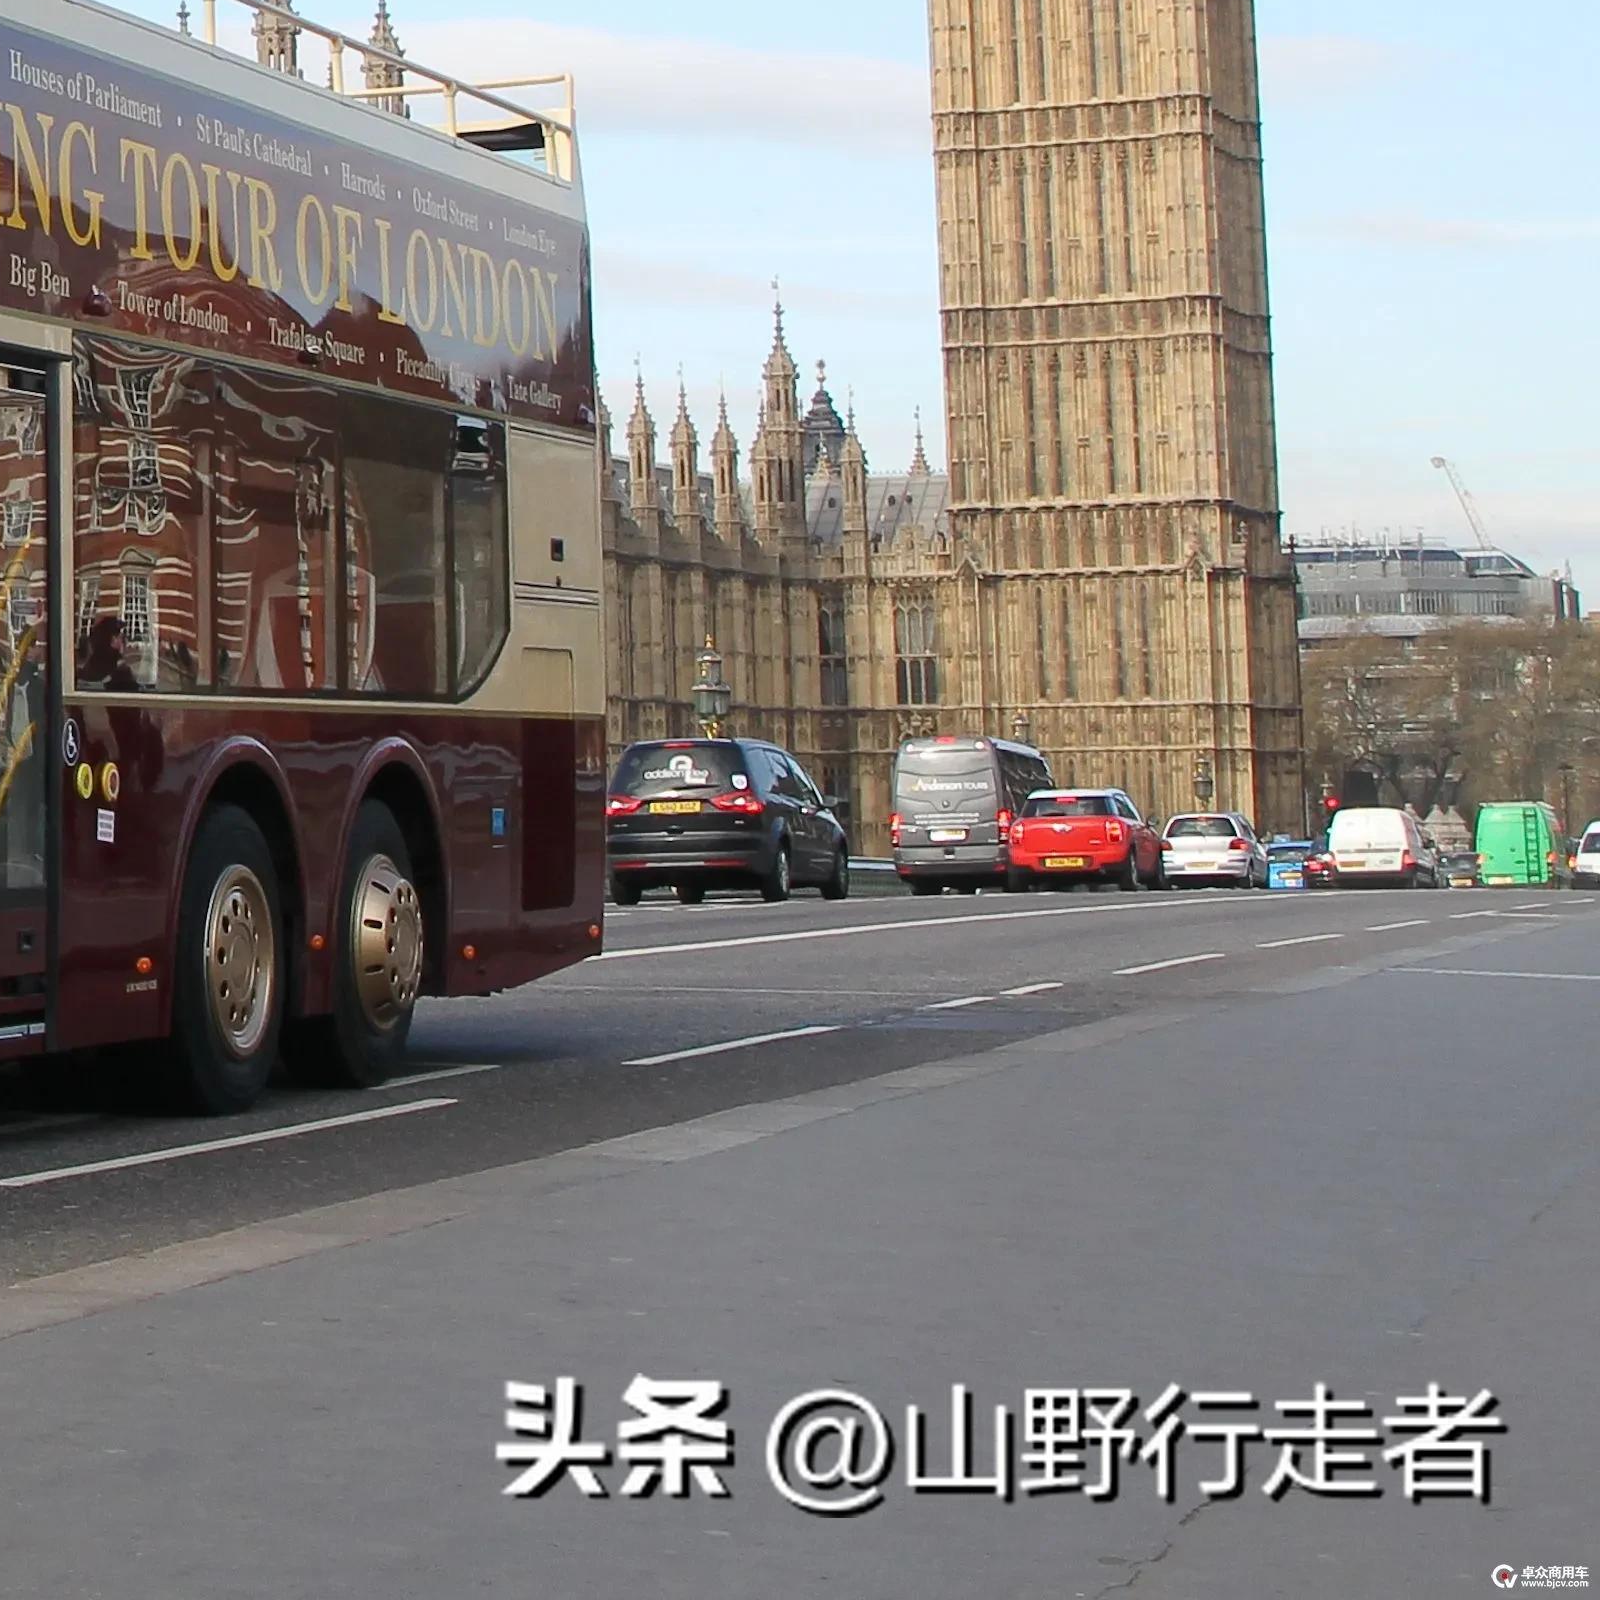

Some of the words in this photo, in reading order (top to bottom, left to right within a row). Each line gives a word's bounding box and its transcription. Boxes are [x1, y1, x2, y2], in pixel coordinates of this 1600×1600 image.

[9, 48, 64, 96] Houses
[67, 71, 84, 102] of
[84, 74, 162, 129] Parliament
[196, 113, 211, 144] St
[214, 119, 252, 158] Paul's
[253, 132, 313, 177] Cathedral
[341, 161, 386, 201] Harrods
[412, 187, 448, 222] Oxford
[449, 200, 479, 232] Street
[9, 254, 37, 297] Big
[40, 261, 71, 298] Ben
[117, 279, 161, 319] Tower
[163, 294, 179, 323] of
[179, 295, 230, 335] London
[325, 330, 366, 366] Square
[395, 347, 446, 389] Piccadilly
[507, 374, 528, 403] Tate
[529, 380, 563, 415] Gallery
[119, 137, 283, 292] TOUR
[297, 194, 364, 314] OF
[374, 217, 559, 366] LONDON
